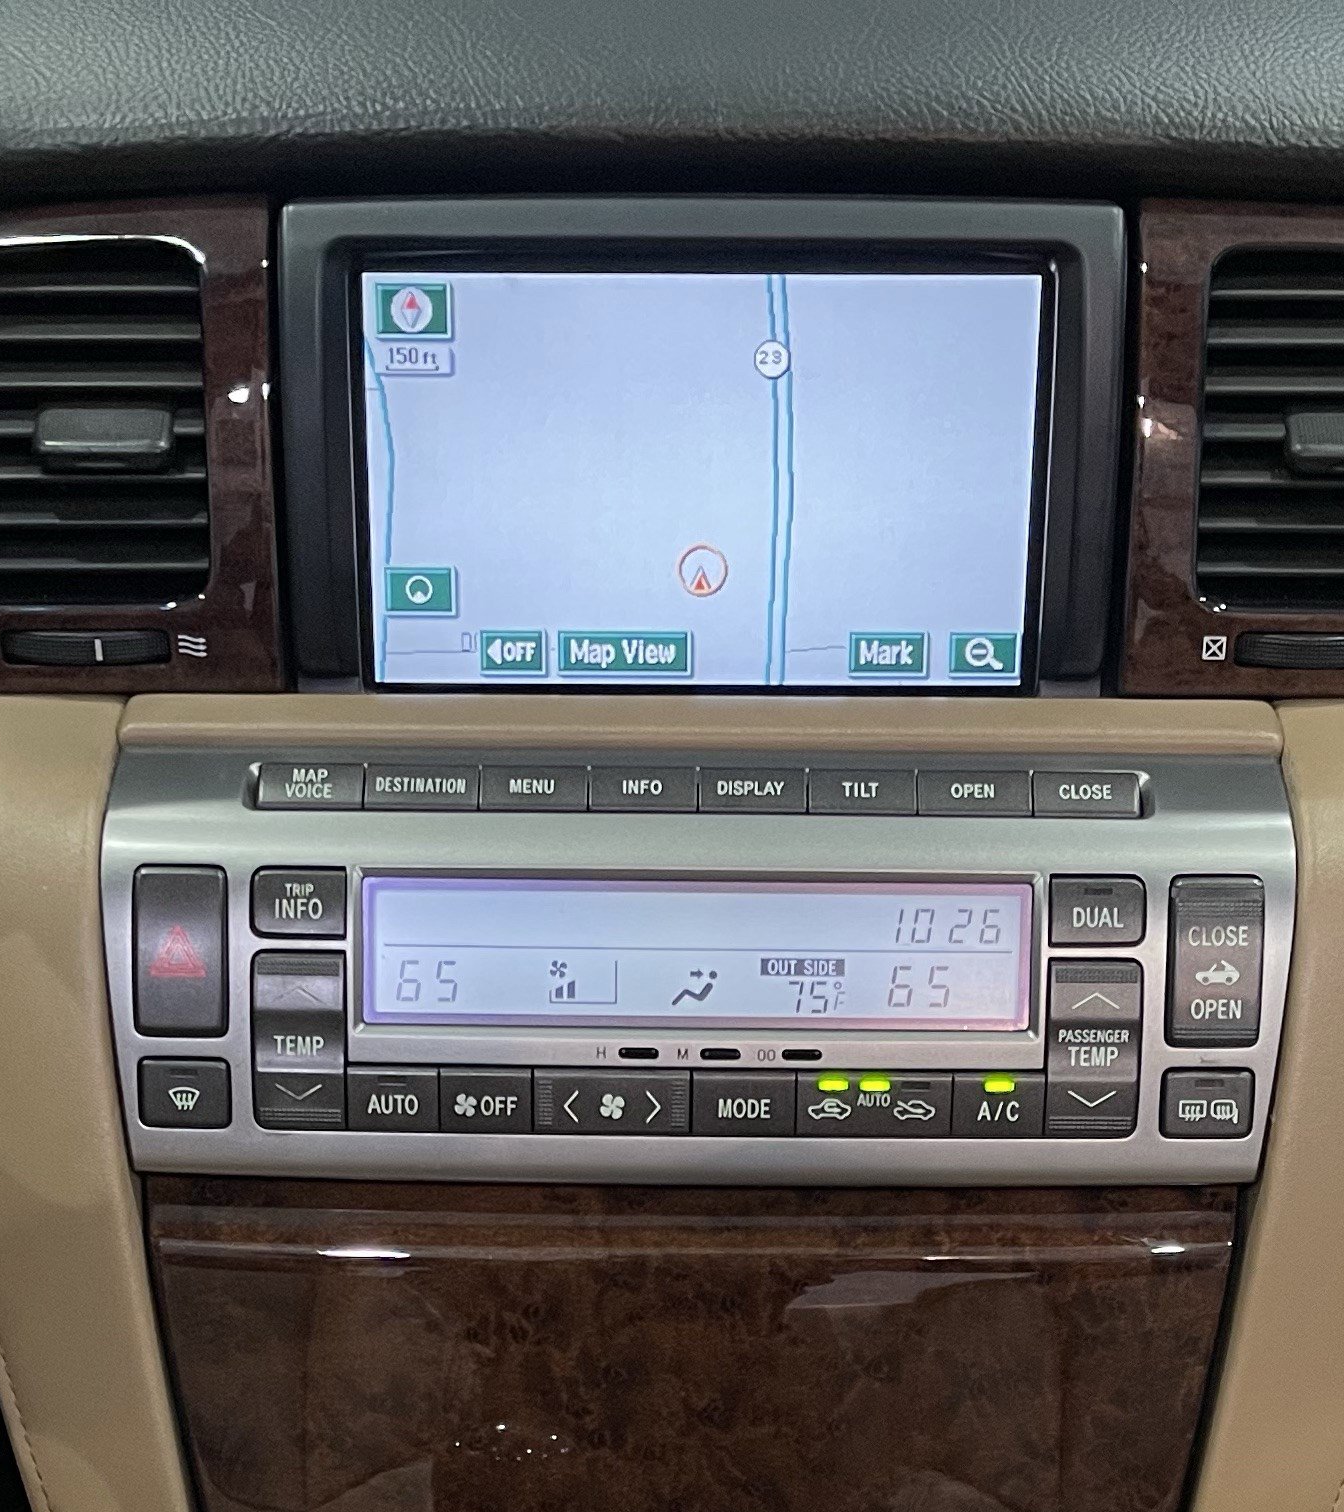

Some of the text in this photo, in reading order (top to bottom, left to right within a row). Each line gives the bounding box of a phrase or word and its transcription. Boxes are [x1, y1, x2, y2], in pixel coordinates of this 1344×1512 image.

[389, 347, 437, 365] 150 ft
[504, 642, 536, 661] OFF
[570, 639, 676, 666] Map View
[860, 640, 913, 664] Mark
[293, 769, 328, 783] MAP
[376, 777, 465, 793] DESTINATION
[286, 783, 332, 798] VOICE
[510, 779, 554, 793] MENU
[623, 780, 662, 794] INFO
[717, 781, 784, 795] DISPLAY
[842, 782, 878, 797] TILT
[951, 783, 994, 798] OPEN
[1059, 784, 1112, 799] CLOSE
[285, 883, 313, 897] TRIP
[275, 898, 322, 919] INFO
[1073, 907, 1124, 928] DUAL
[1189, 926, 1248, 946] CLOSE
[767, 960, 837, 976] OUT SIDE
[396, 960, 458, 1002] 65
[888, 966, 949, 1007] 65
[1190, 997, 1242, 1020] OPEN
[1059, 1030, 1129, 1043] PASSENGER
[273, 1036, 325, 1056] TEMP
[596, 1047, 606, 1058] H
[678, 1049, 688, 1059] M
[1068, 1047, 1118, 1066] TEMP
[368, 1094, 418, 1115] AUTO
[481, 1096, 517, 1115] OFF
[718, 1098, 770, 1118] MODE
[857, 1092, 891, 1108] AUTO
[978, 1101, 1019, 1121] A/C
